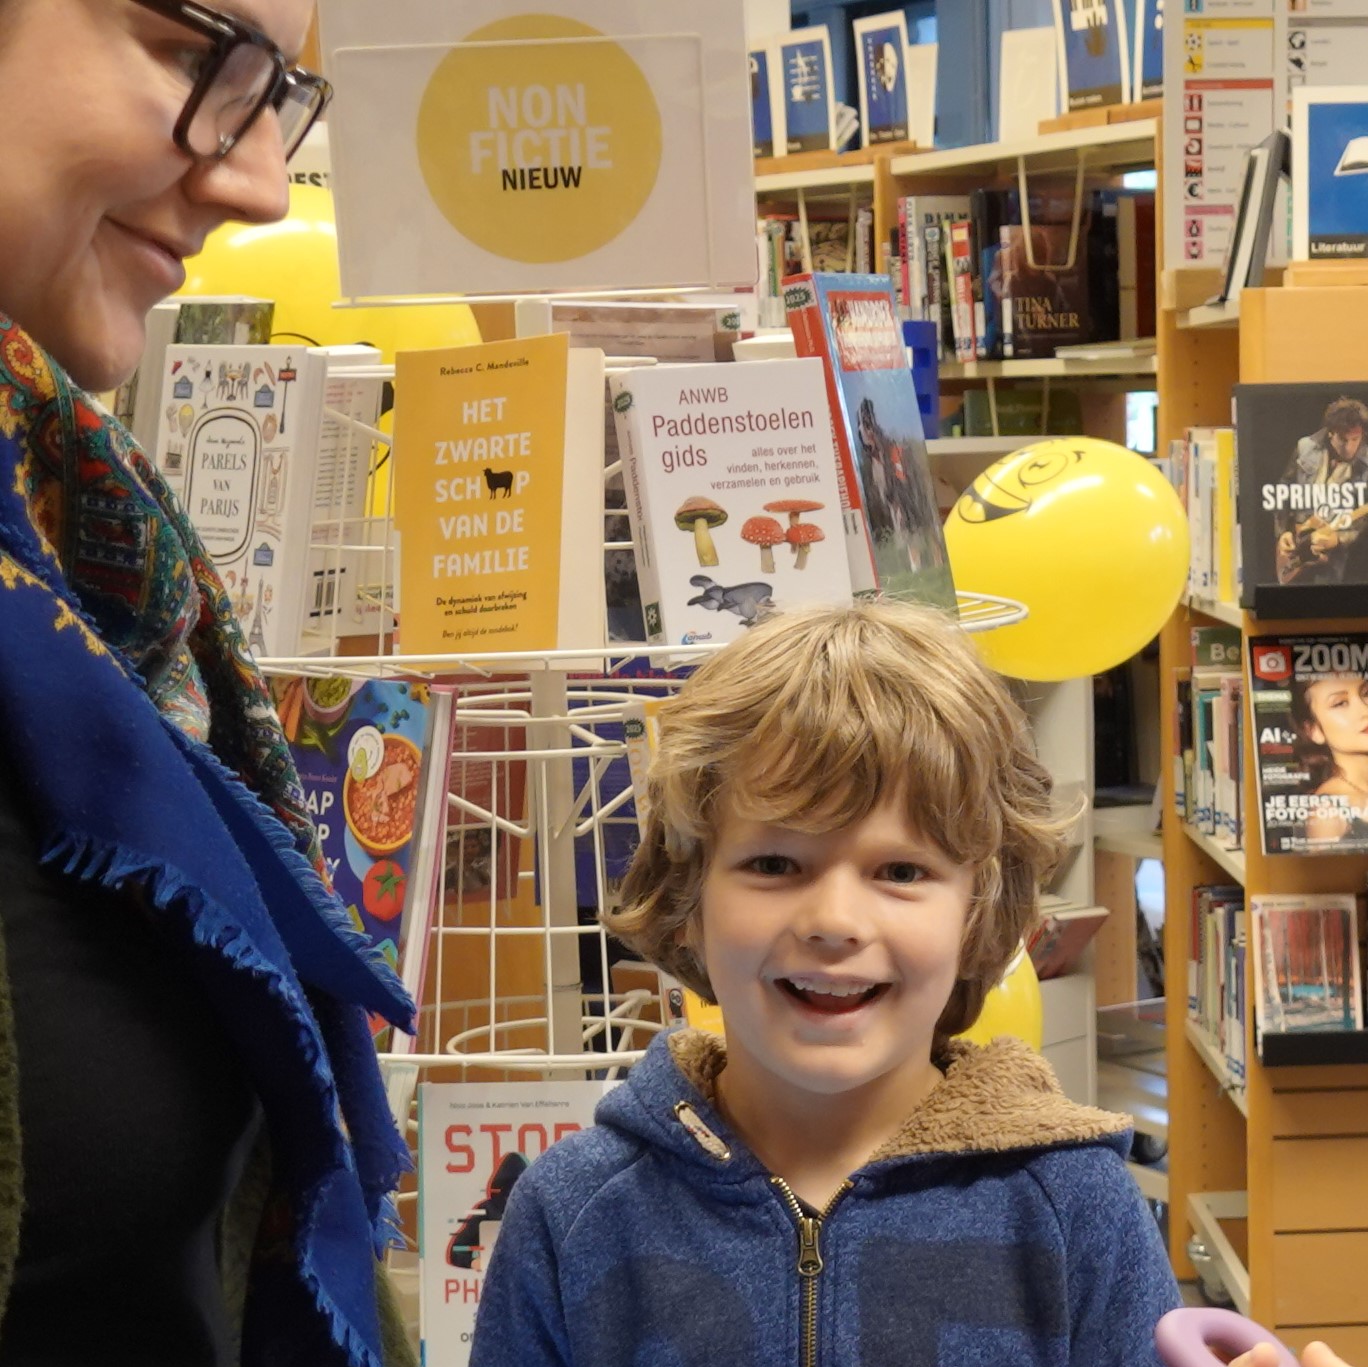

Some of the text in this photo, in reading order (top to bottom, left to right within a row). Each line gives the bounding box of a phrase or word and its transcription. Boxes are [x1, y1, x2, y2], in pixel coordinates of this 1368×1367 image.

[487, 83, 587, 129] NON
[468, 126, 613, 174] FICTIE
[502, 166, 582, 190] NIEUW
[1311, 242, 1366, 253] Literatuur
[1016, 297, 1051, 312] TINA
[1016, 313, 1080, 329] TURNER
[678, 387, 728, 404] ANWB
[462, 397, 507, 424] HET
[652, 408, 814, 437] Paddenstoelen
[434, 432, 532, 465] ZWARTE
[752, 443, 816, 457] alles over het
[201, 452, 247, 471] PARELS
[661, 446, 708, 473] gids
[726, 460, 819, 475] vinden, herkennen,
[213, 479, 230, 491] VAN
[710, 473, 820, 490] verzamelen en gebruik
[200, 497, 239, 517] PARIJS
[438, 508, 524, 540] VAN DE
[432, 546, 529, 578] FAMILIE
[1260, 727, 1281, 743] AI
[1265, 795, 1350, 809] JE EERSTE
